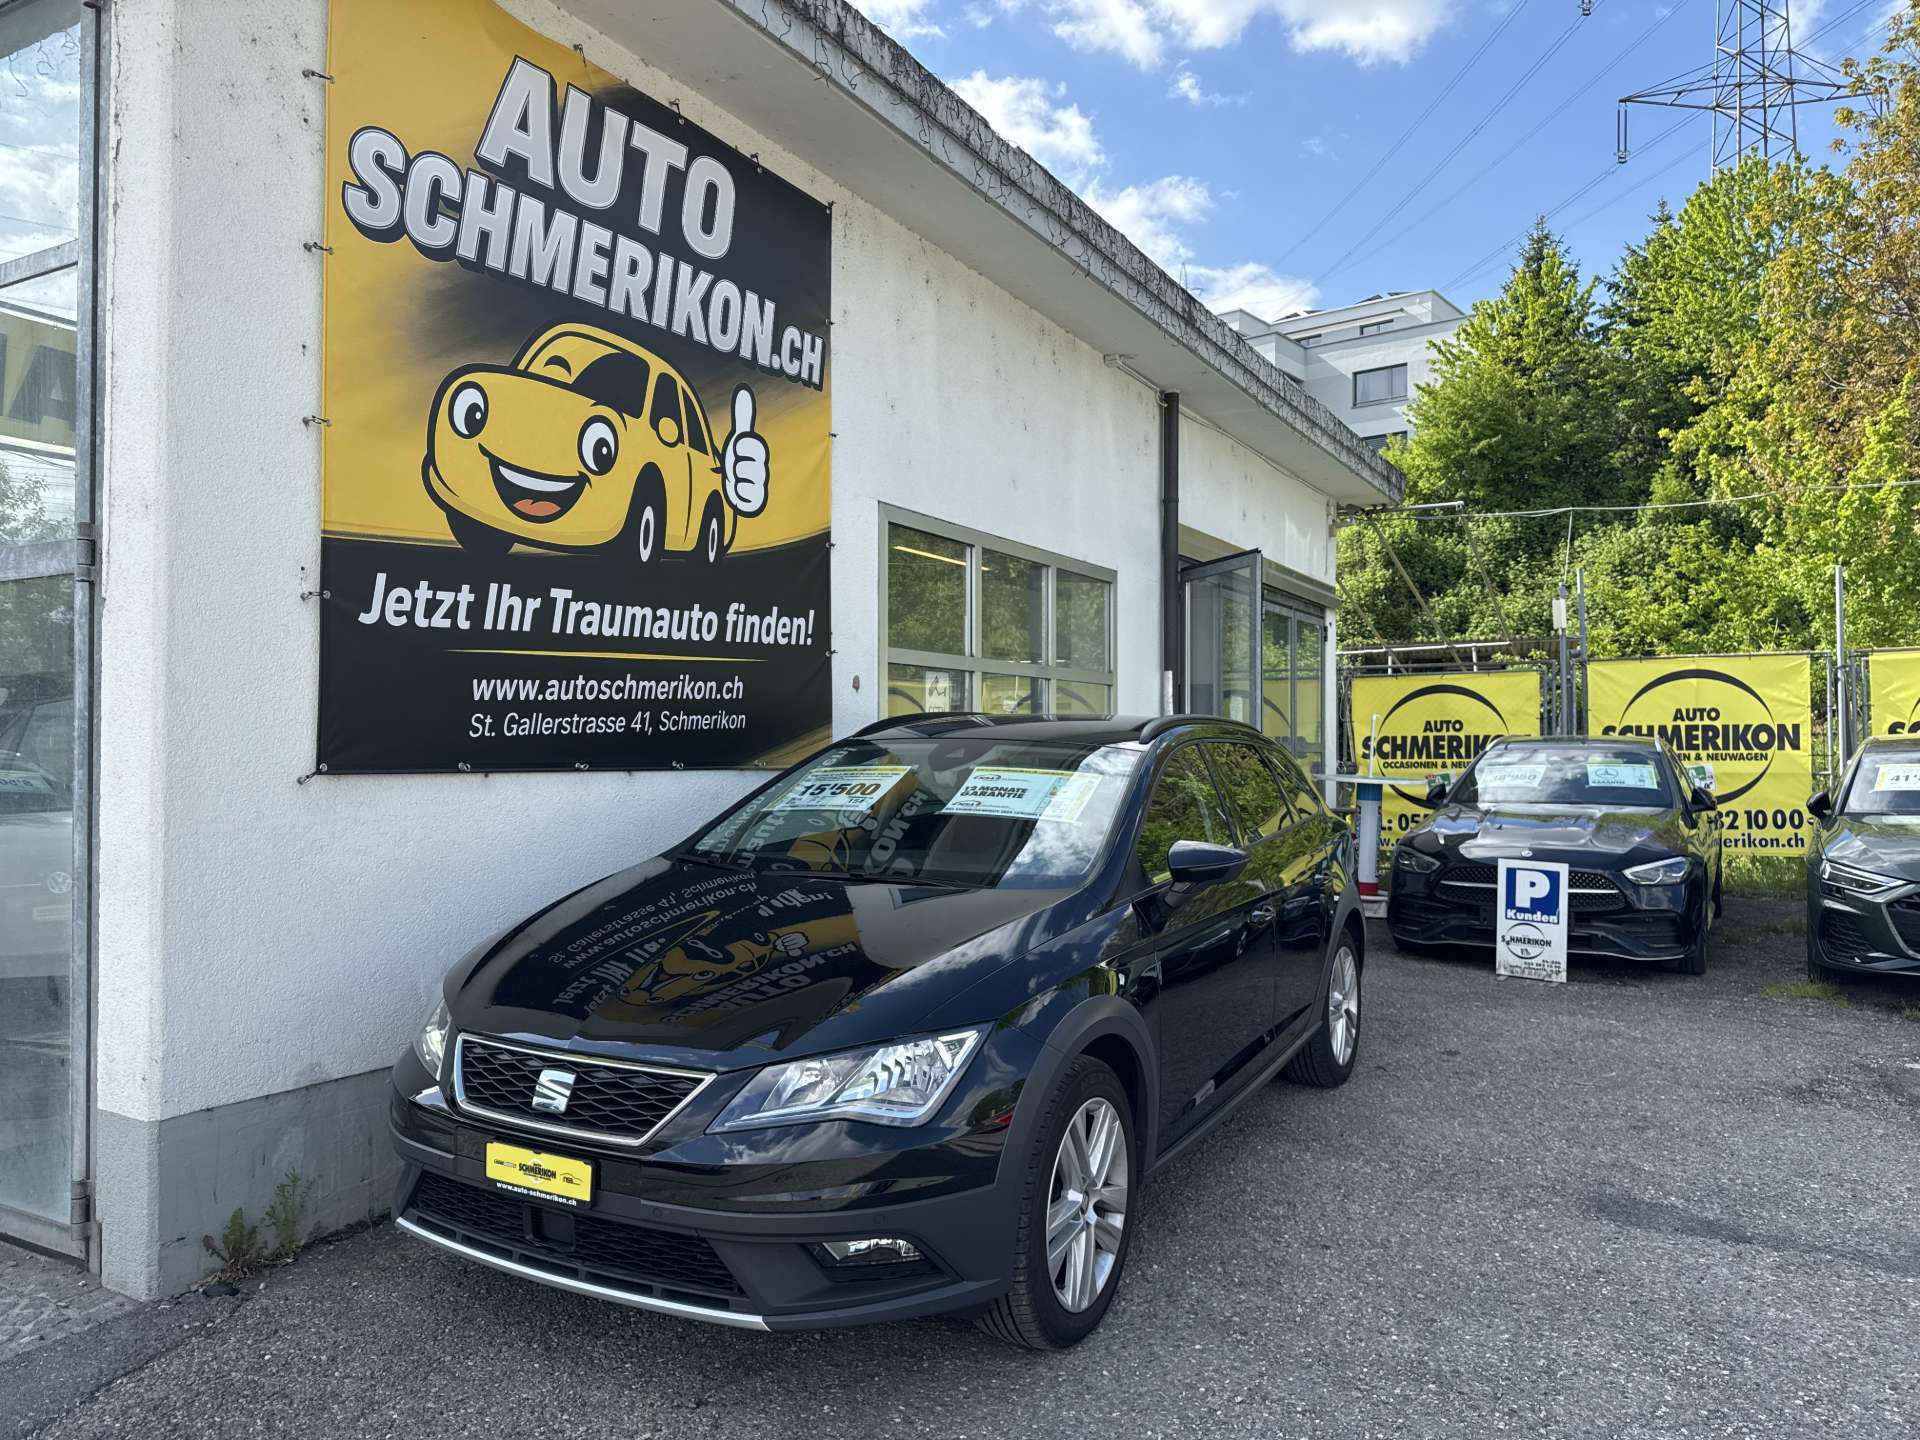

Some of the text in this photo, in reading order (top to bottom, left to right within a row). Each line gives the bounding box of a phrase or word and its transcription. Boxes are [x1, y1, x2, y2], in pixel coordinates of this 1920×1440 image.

[475, 56, 736, 260] AUTO
[344, 128, 824, 386] SCHMERIKON.CH
[358, 572, 815, 646] Jetzt Ihr Traumauto finden!
[471, 674, 744, 701] www.autoschmerikon.ch
[1673, 707, 1720, 722] AUTO
[468, 710, 746, 738] St. Gallerstrasse 41, Schmerikon
[1423, 720, 1464, 733] AUTO
[1361, 734, 1504, 760] SCHMERIK
[1382, 761, 1439, 769] OCCASIONEN
[1707, 752, 1769, 761] NEUWAGEN
[799, 783, 881, 796] 15'500
[960, 790, 1026, 799] GARANTIE
[979, 786, 1029, 794] MONATE
[1744, 809, 1768, 830] 10
[1772, 809, 1804, 830] 00
[1723, 832, 1805, 848] erikon.ch
[1515, 869, 1550, 908] P
[1506, 908, 1559, 924] Kunden
[518, 1162, 557, 1179] SCHMERIKON
[496, 1181, 577, 1207] www.auto-schmerikon.ch
